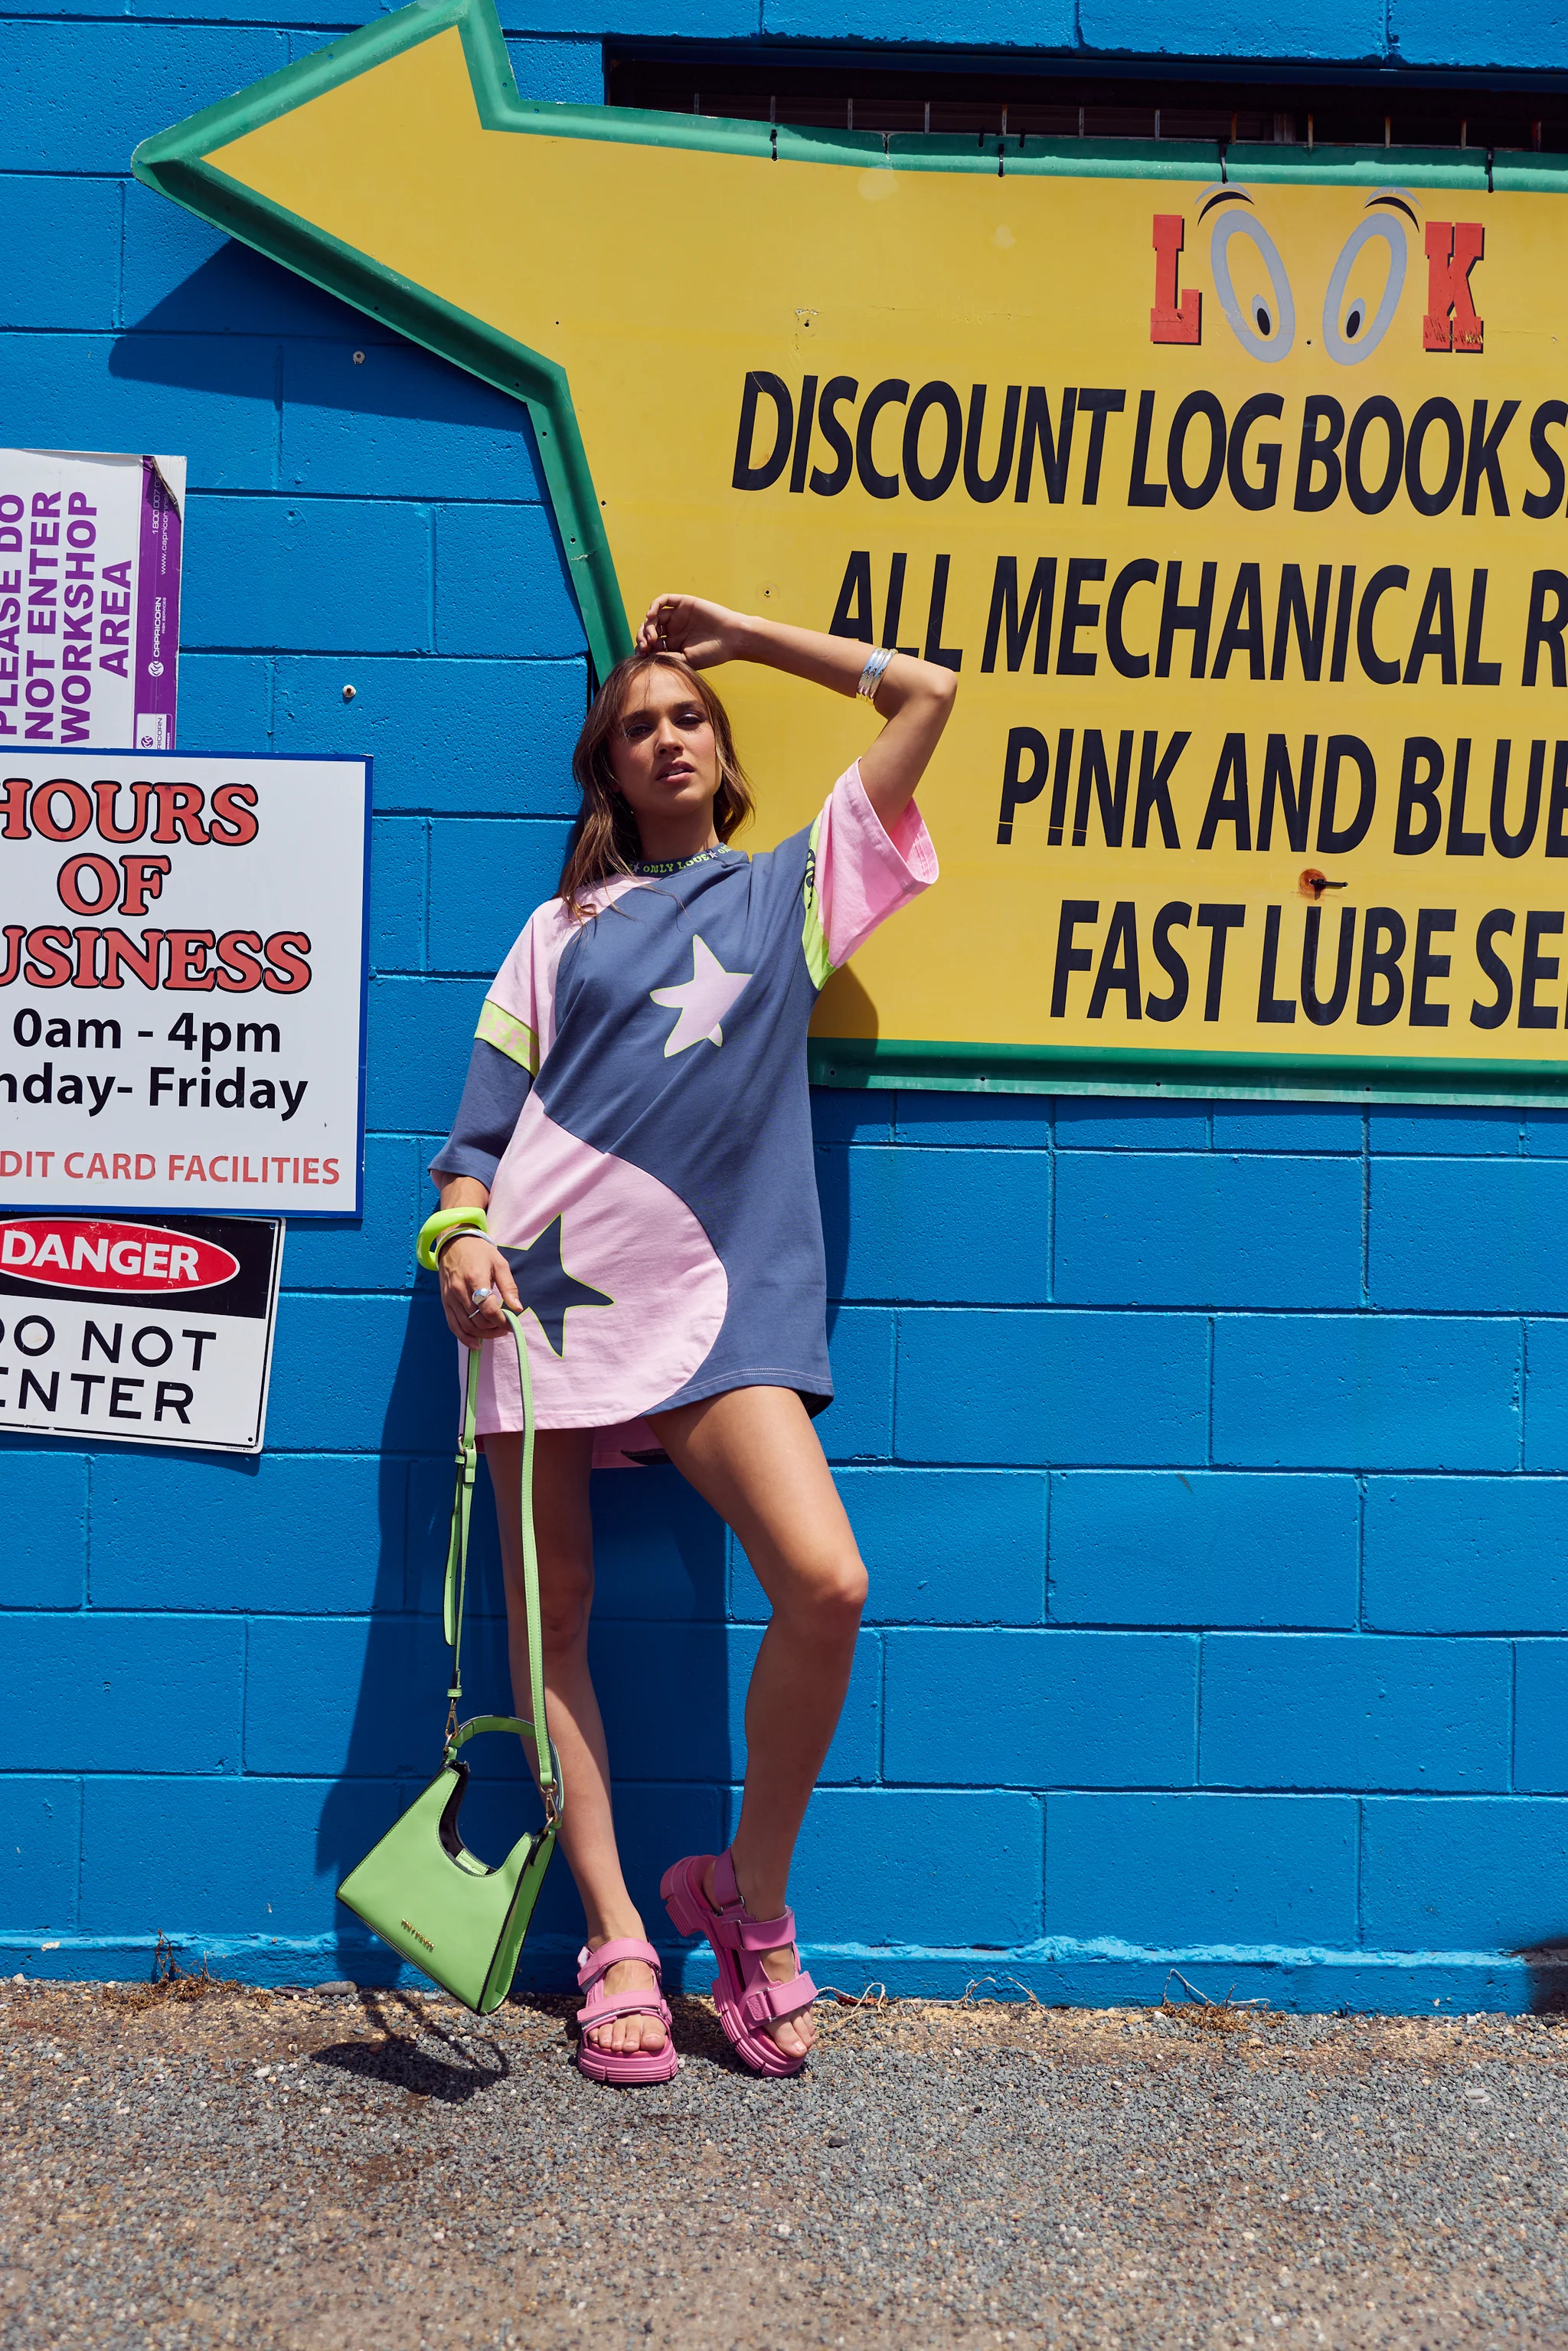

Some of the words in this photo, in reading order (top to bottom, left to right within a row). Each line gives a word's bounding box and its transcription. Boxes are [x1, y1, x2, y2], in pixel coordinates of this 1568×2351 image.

[1150, 209, 1485, 366] LOOK
[731, 371, 1127, 505] DISCOUNT
[1128, 390, 1285, 512] LOG
[1293, 394, 1522, 517] BOOK
[1522, 400, 1568, 518] S
[0, 494, 24, 552] DO
[27, 492, 61, 634] ENTER
[60, 492, 97, 744] WORKSHOP
[99, 561, 132, 678] AREA
[153, 597, 162, 658] CAPRICORN
[828, 551, 963, 672] ALL
[980, 555, 1502, 686] MECHANICAL
[24, 650, 54, 740] NOT
[996, 726, 1193, 849] PINK
[1196, 732, 1377, 854] AND
[57, 853, 172, 916] OF
[642, 863, 675, 873] ONLY
[1050, 899, 1246, 1022] FAST
[1256, 904, 1457, 1027] LUBE
[1469, 908, 1568, 1030] SE
[13, 1008, 121, 1049] 0am
[168, 1012, 280, 1063] 4pm
[149, 1066, 309, 1122] Friday
[0, 1150, 55, 1178] DIT
[64, 1152, 155, 1180] CARD
[168, 1154, 340, 1185] FACILITIES
[1, 1229, 200, 1281] DANGER
[0, 1316, 55, 1357] O
[81, 1320, 217, 1372] NOT
[0, 1367, 194, 1424] NTER
